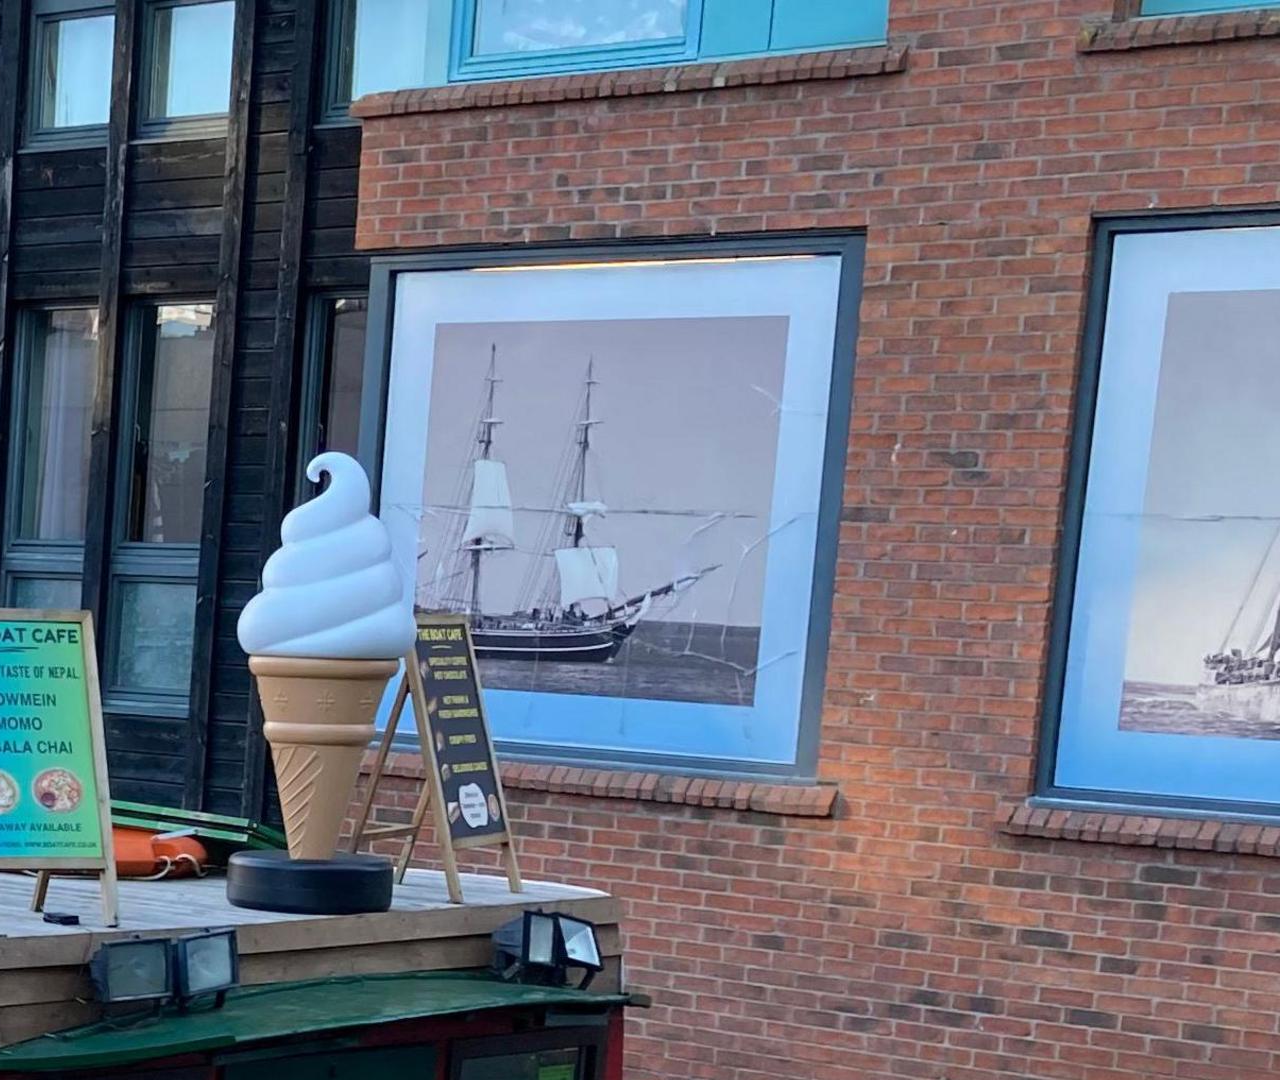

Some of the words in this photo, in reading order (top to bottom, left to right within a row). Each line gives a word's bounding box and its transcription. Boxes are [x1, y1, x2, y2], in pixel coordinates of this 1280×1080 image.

[31, 629, 79, 644] CAFE
[0, 665, 31, 679] TASTE
[33, 666, 44, 679] OF
[36, 741, 73, 754] CHAI
[29, 823, 82, 833] AVAILABLE
